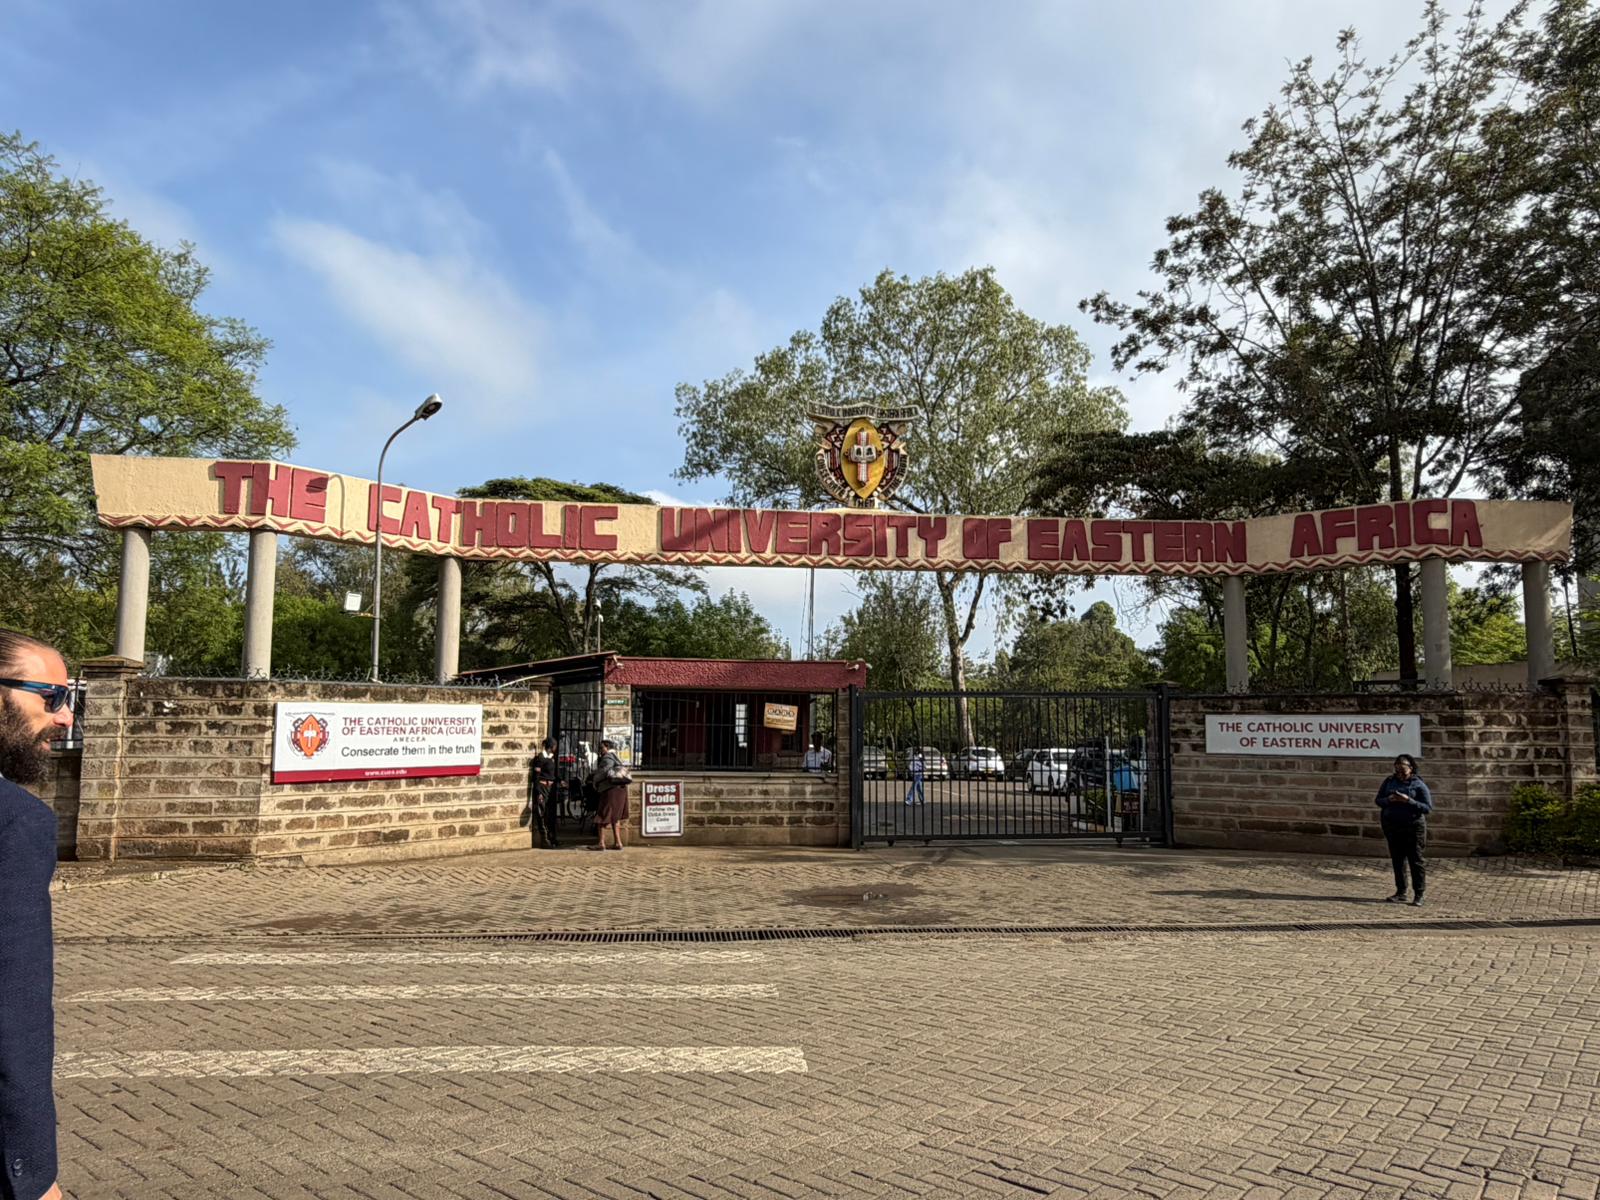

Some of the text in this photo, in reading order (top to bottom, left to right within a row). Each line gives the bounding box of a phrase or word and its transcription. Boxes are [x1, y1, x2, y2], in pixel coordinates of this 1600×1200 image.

[215, 461, 1483, 563] THE CATHOLIC UNIVERSITY OF EASTERN AFRICA
[342, 716, 476, 726] THE CATHOLIC UNIVERSITY
[342, 726, 477, 737] OF EASTERN AFRICA (CUEA)
[1218, 722, 1404, 734] THE CATHOLIC UNIVERSITY
[1239, 737, 1381, 749] OF EASTERN AFRICA
[341, 744, 475, 757] Consecrate them in the truth
[646, 784, 677, 794] Dress
[649, 793, 676, 803] Code
